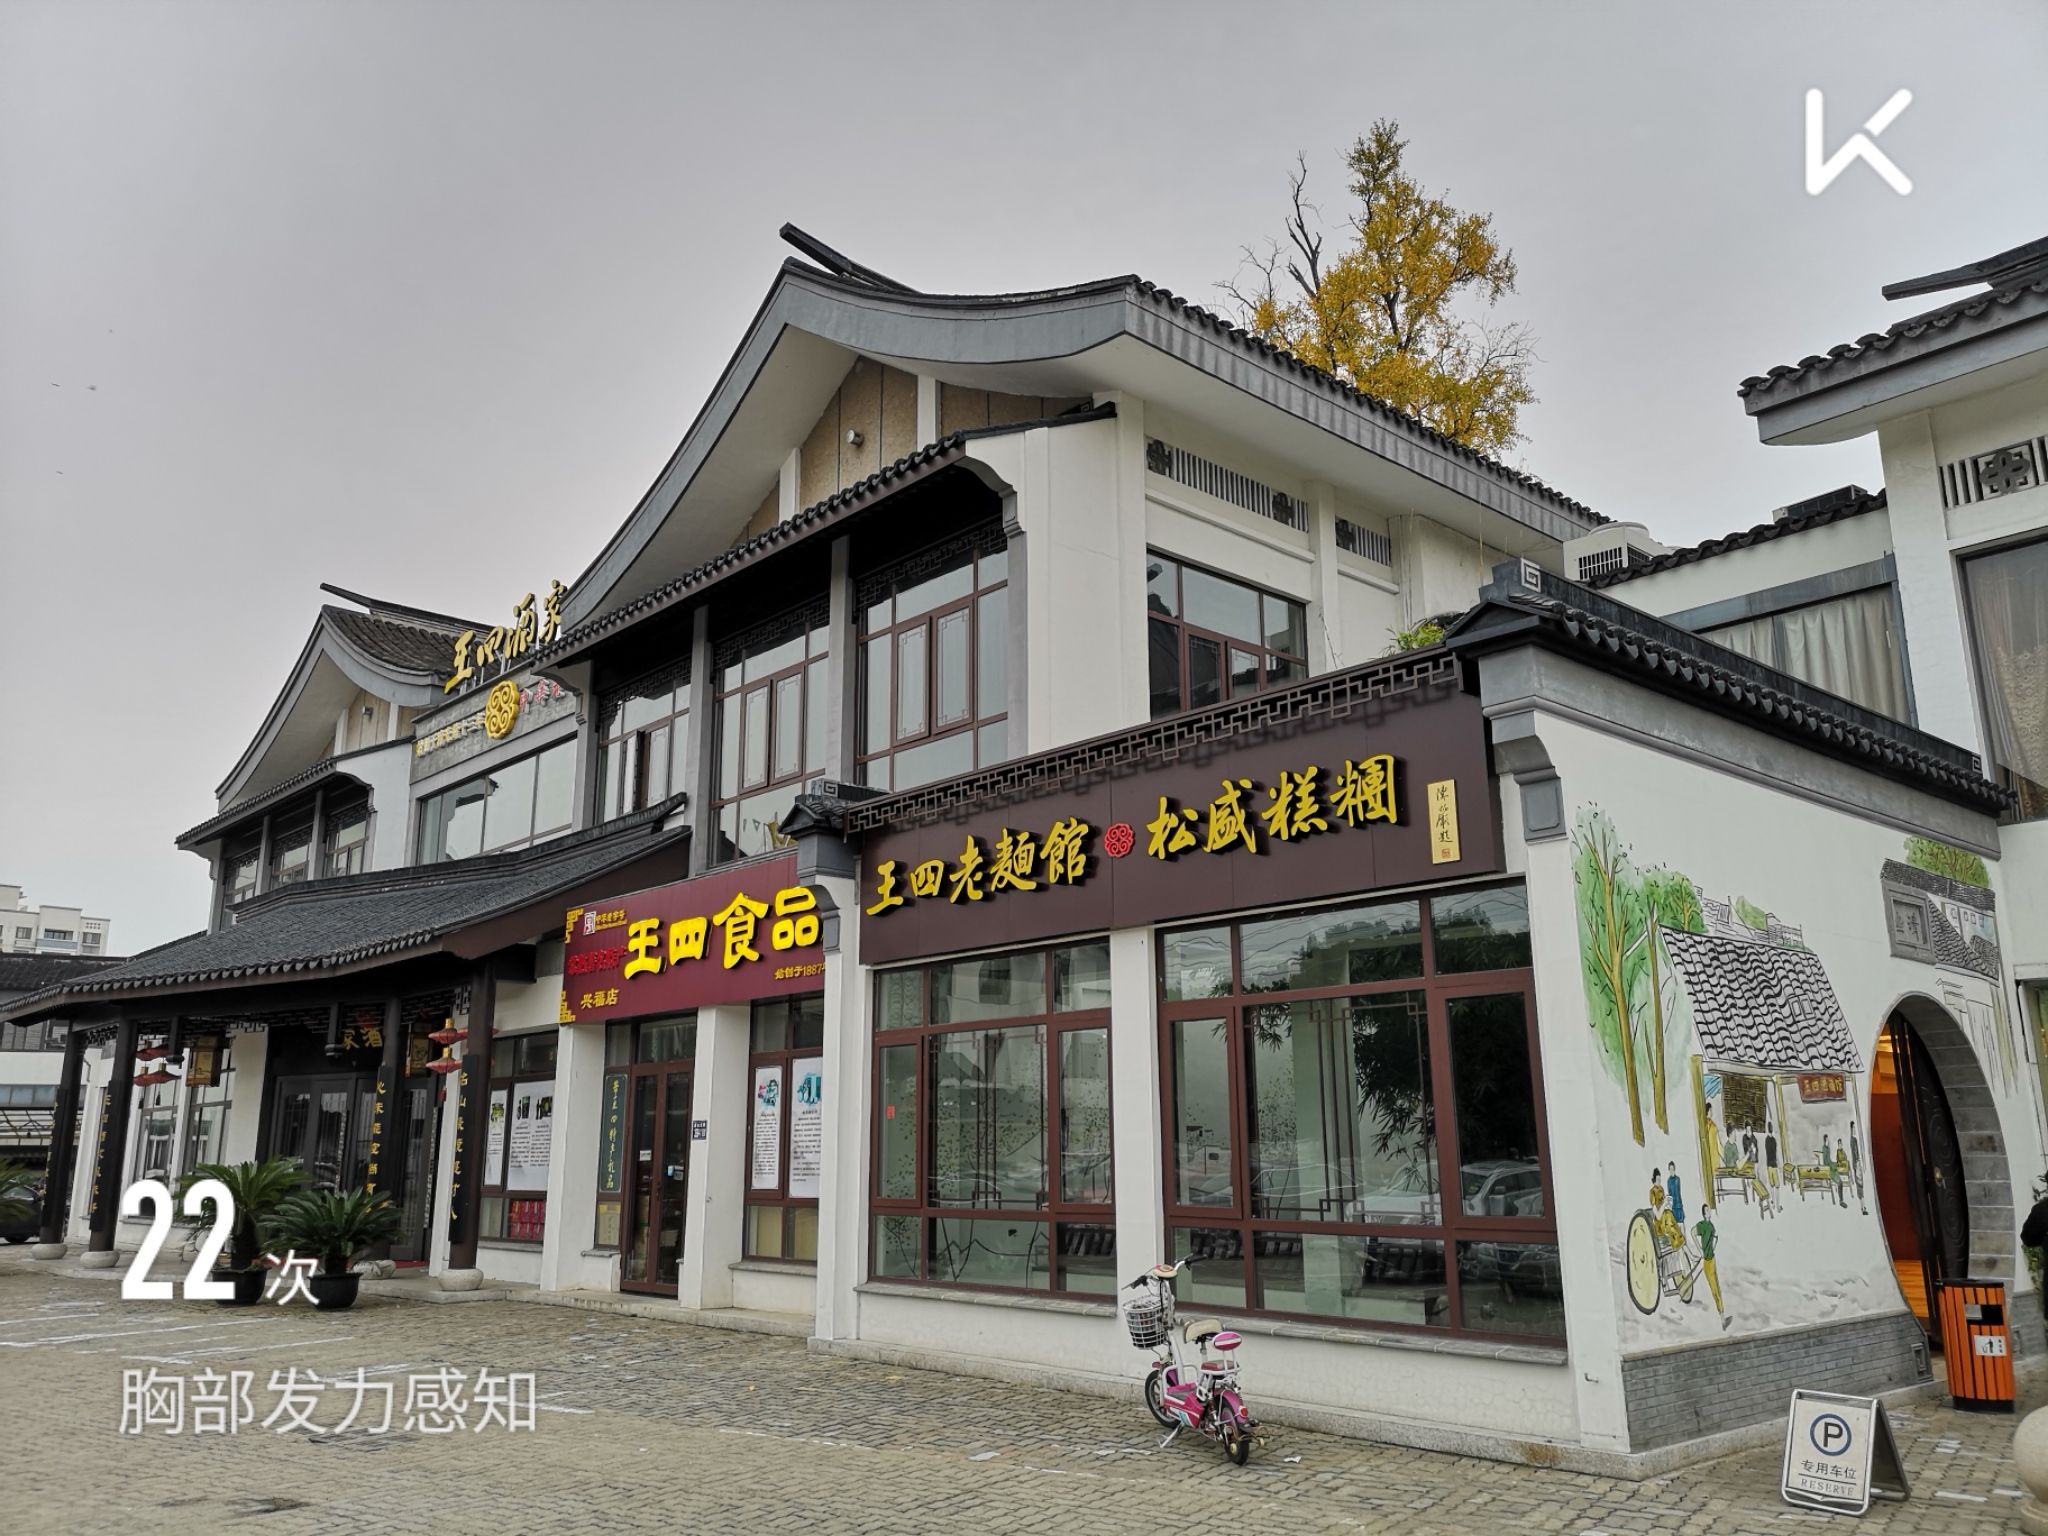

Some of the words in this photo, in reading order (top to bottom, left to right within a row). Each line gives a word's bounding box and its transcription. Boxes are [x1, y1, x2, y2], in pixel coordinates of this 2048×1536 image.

[624, 886, 820, 980] 王四食品
[580, 988, 620, 1009] 兴福店
[1823, 1421, 1844, 1448] P
[1800, 1459, 1857, 1480] 专用车位
[1800, 1478, 1855, 1497] RESERVE
